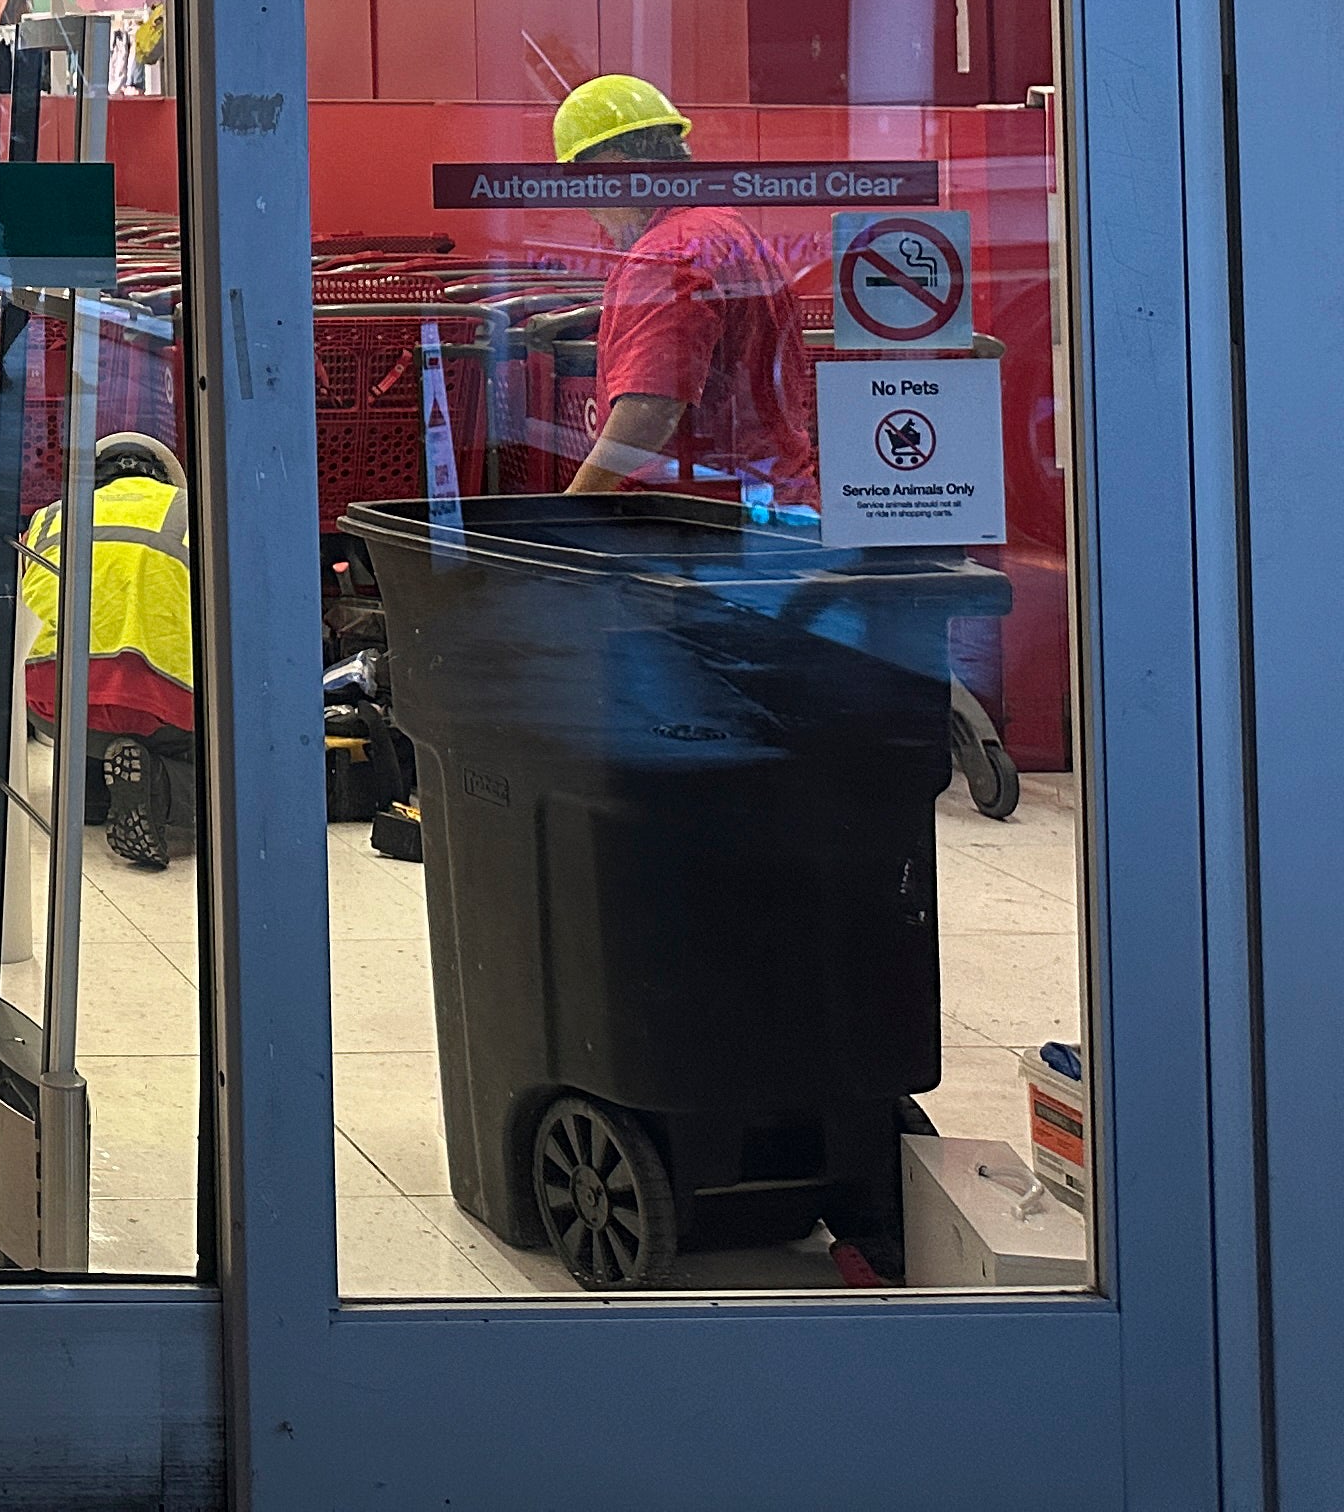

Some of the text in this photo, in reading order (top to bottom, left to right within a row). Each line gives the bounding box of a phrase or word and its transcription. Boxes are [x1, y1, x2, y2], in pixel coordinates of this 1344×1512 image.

[471, 174, 622, 199] Automatic
[630, 173, 702, 197] Door
[733, 171, 817, 197] Stand
[824, 170, 903, 197] Clear
[871, 380, 939, 396] No Pets
[842, 483, 975, 497] Service Animals Only
[857, 501, 884, 509] Service
[885, 500, 913, 509] animals
[914, 500, 938, 508] should
[939, 500, 952, 508] not
